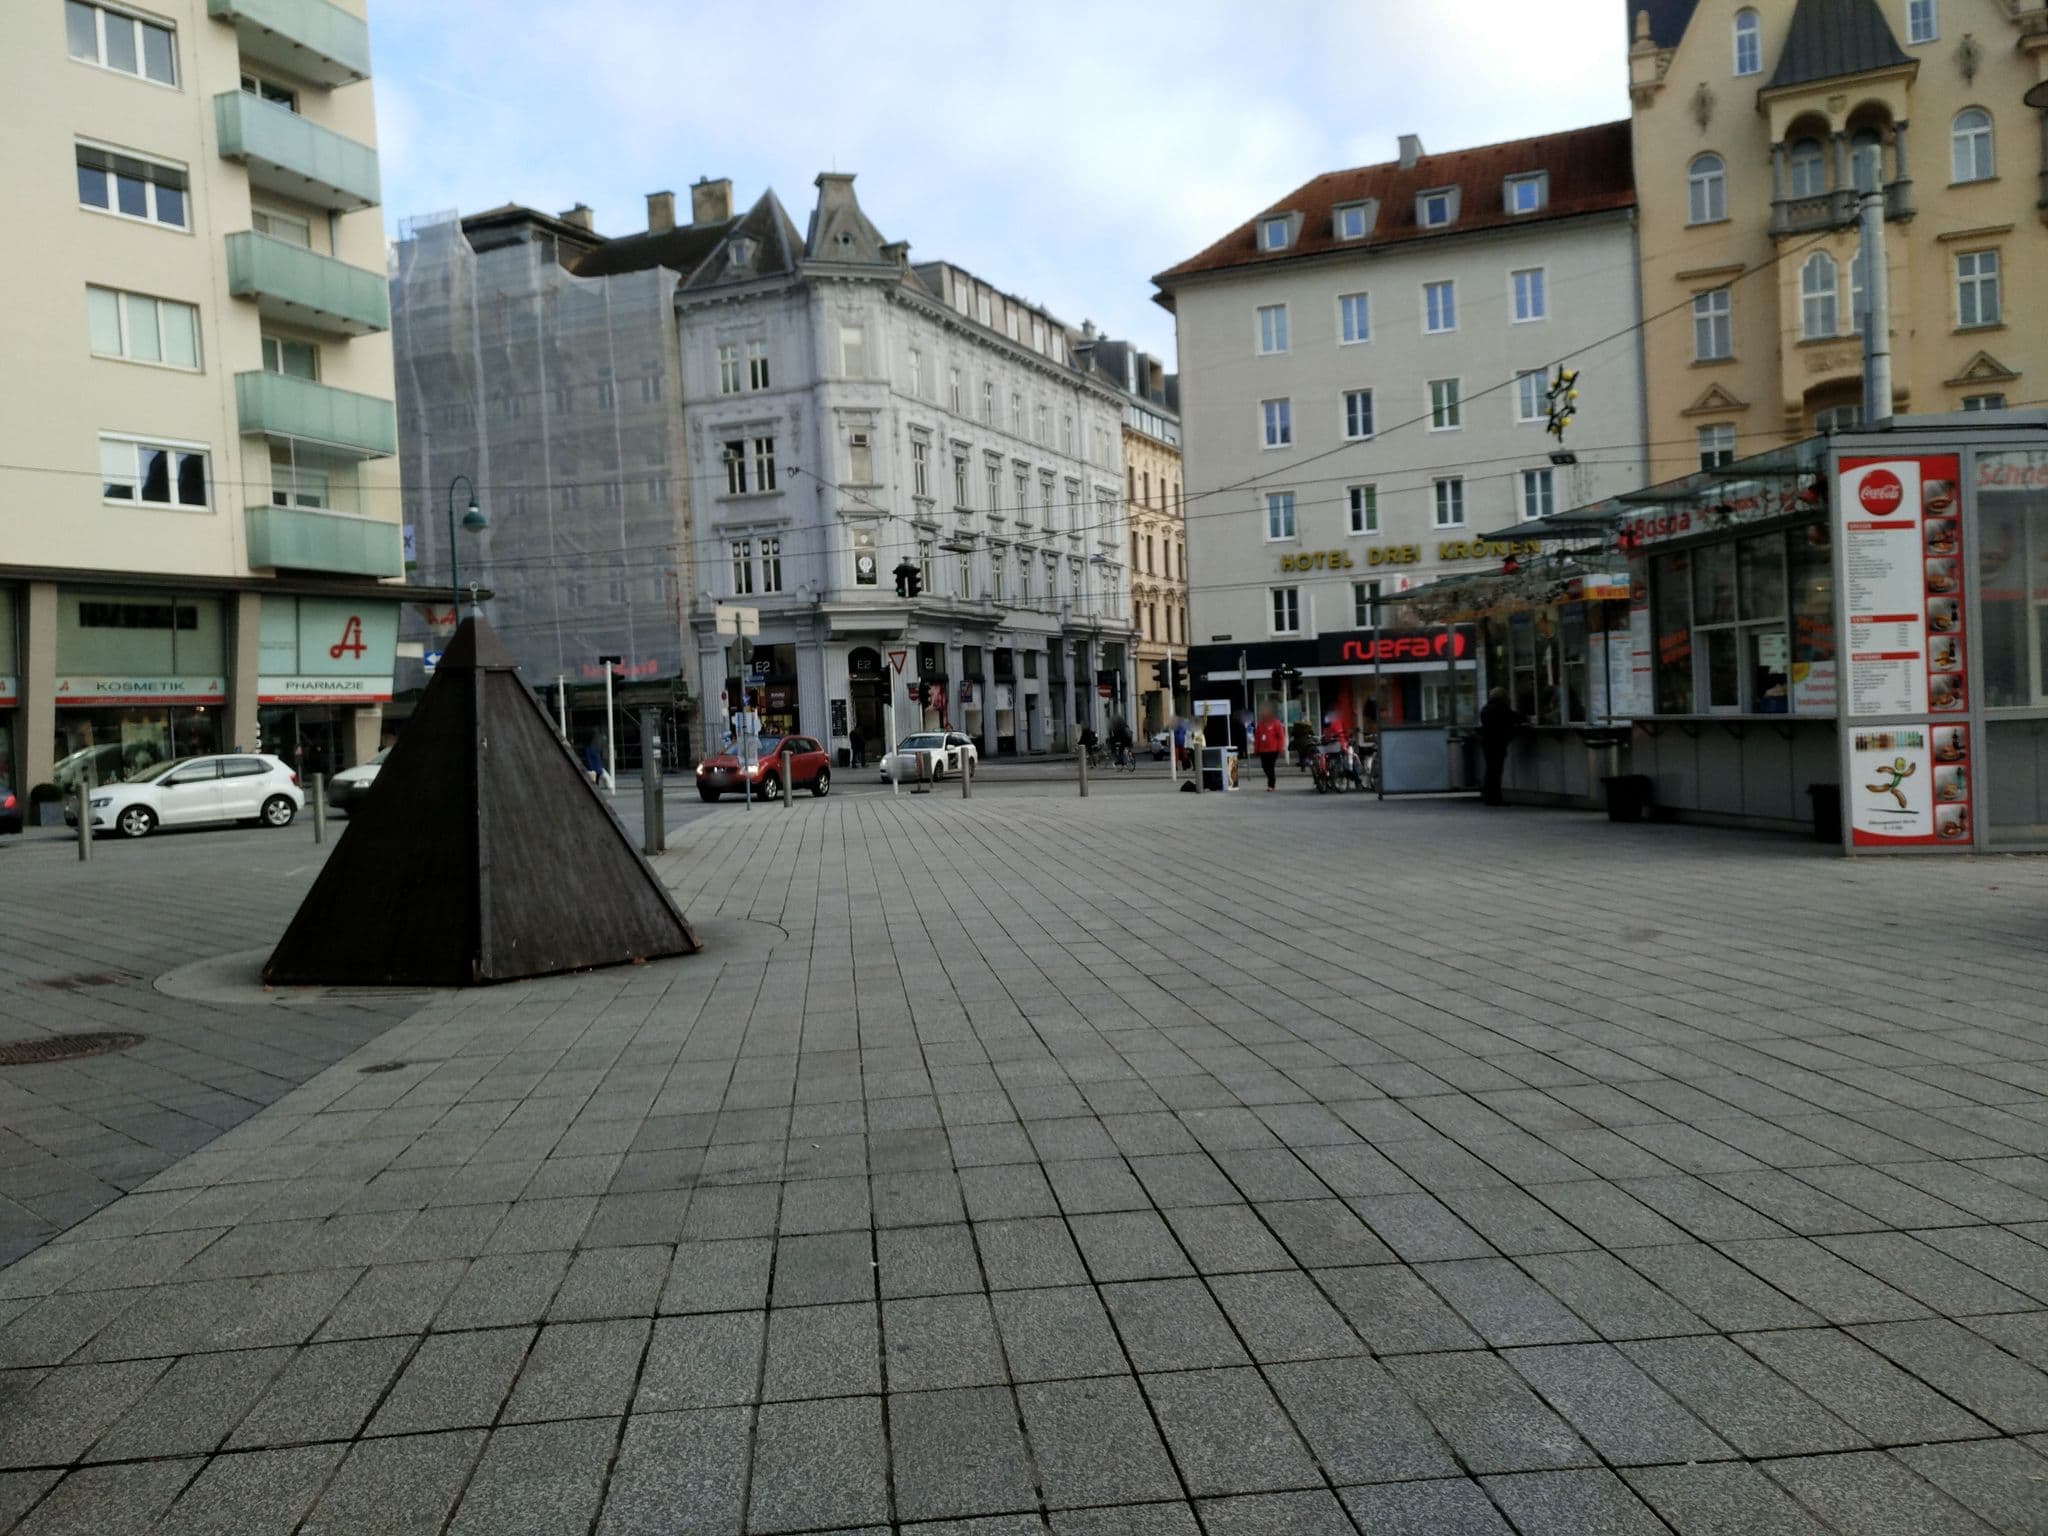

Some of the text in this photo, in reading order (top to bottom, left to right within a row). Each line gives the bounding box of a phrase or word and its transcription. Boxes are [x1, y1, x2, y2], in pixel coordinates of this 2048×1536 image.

[1861, 484, 1900, 501] Coca-Cola
[1280, 549, 1354, 572] HOTEL
[1367, 543, 1422, 566] DREI
[1343, 636, 1431, 661] ruefa
[755, 661, 770, 673] E2
[857, 659, 872, 670] E2
[96, 681, 185, 692] KOSMETIK
[285, 681, 364, 691] PHARMAZIE
